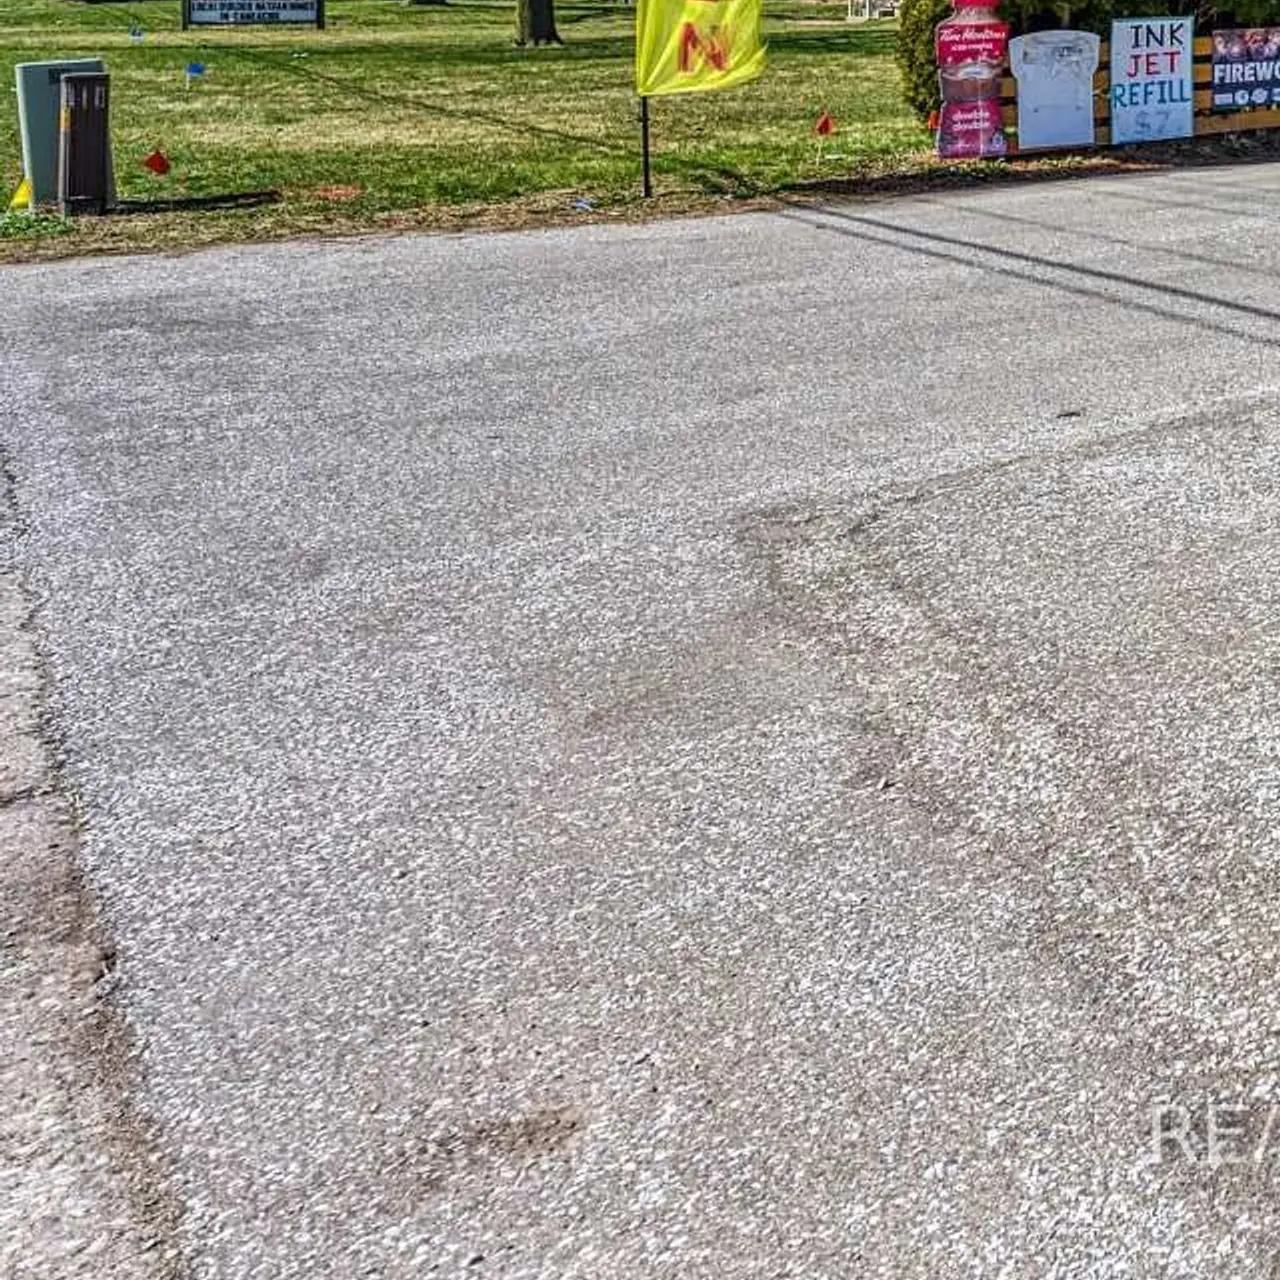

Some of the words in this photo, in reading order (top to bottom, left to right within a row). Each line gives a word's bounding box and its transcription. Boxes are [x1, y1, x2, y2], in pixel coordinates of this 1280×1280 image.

[1130, 23, 1184, 49] INK
[1126, 50, 1181, 78] JET
[1112, 79, 1191, 109] REFILL
